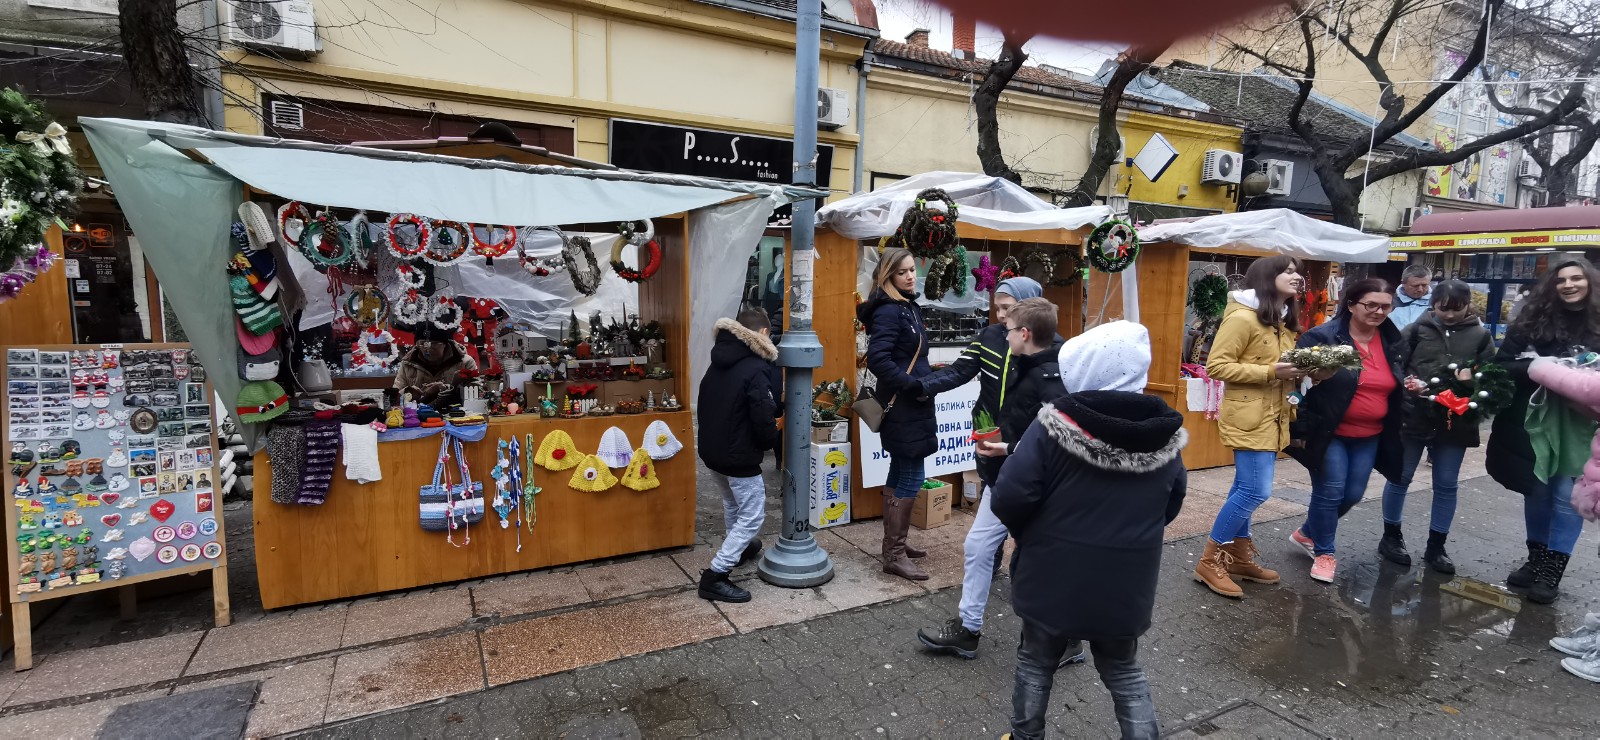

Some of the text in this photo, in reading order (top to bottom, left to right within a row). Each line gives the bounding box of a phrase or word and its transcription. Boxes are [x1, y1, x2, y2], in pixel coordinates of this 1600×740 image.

[757, 169, 778, 180] fashion
[1458, 237, 1506, 246] LIMUNADA
[936, 400, 966, 412] УБЛИКА
[939, 434, 976, 452] АДИКА
[826, 470, 838, 500] BONITA
